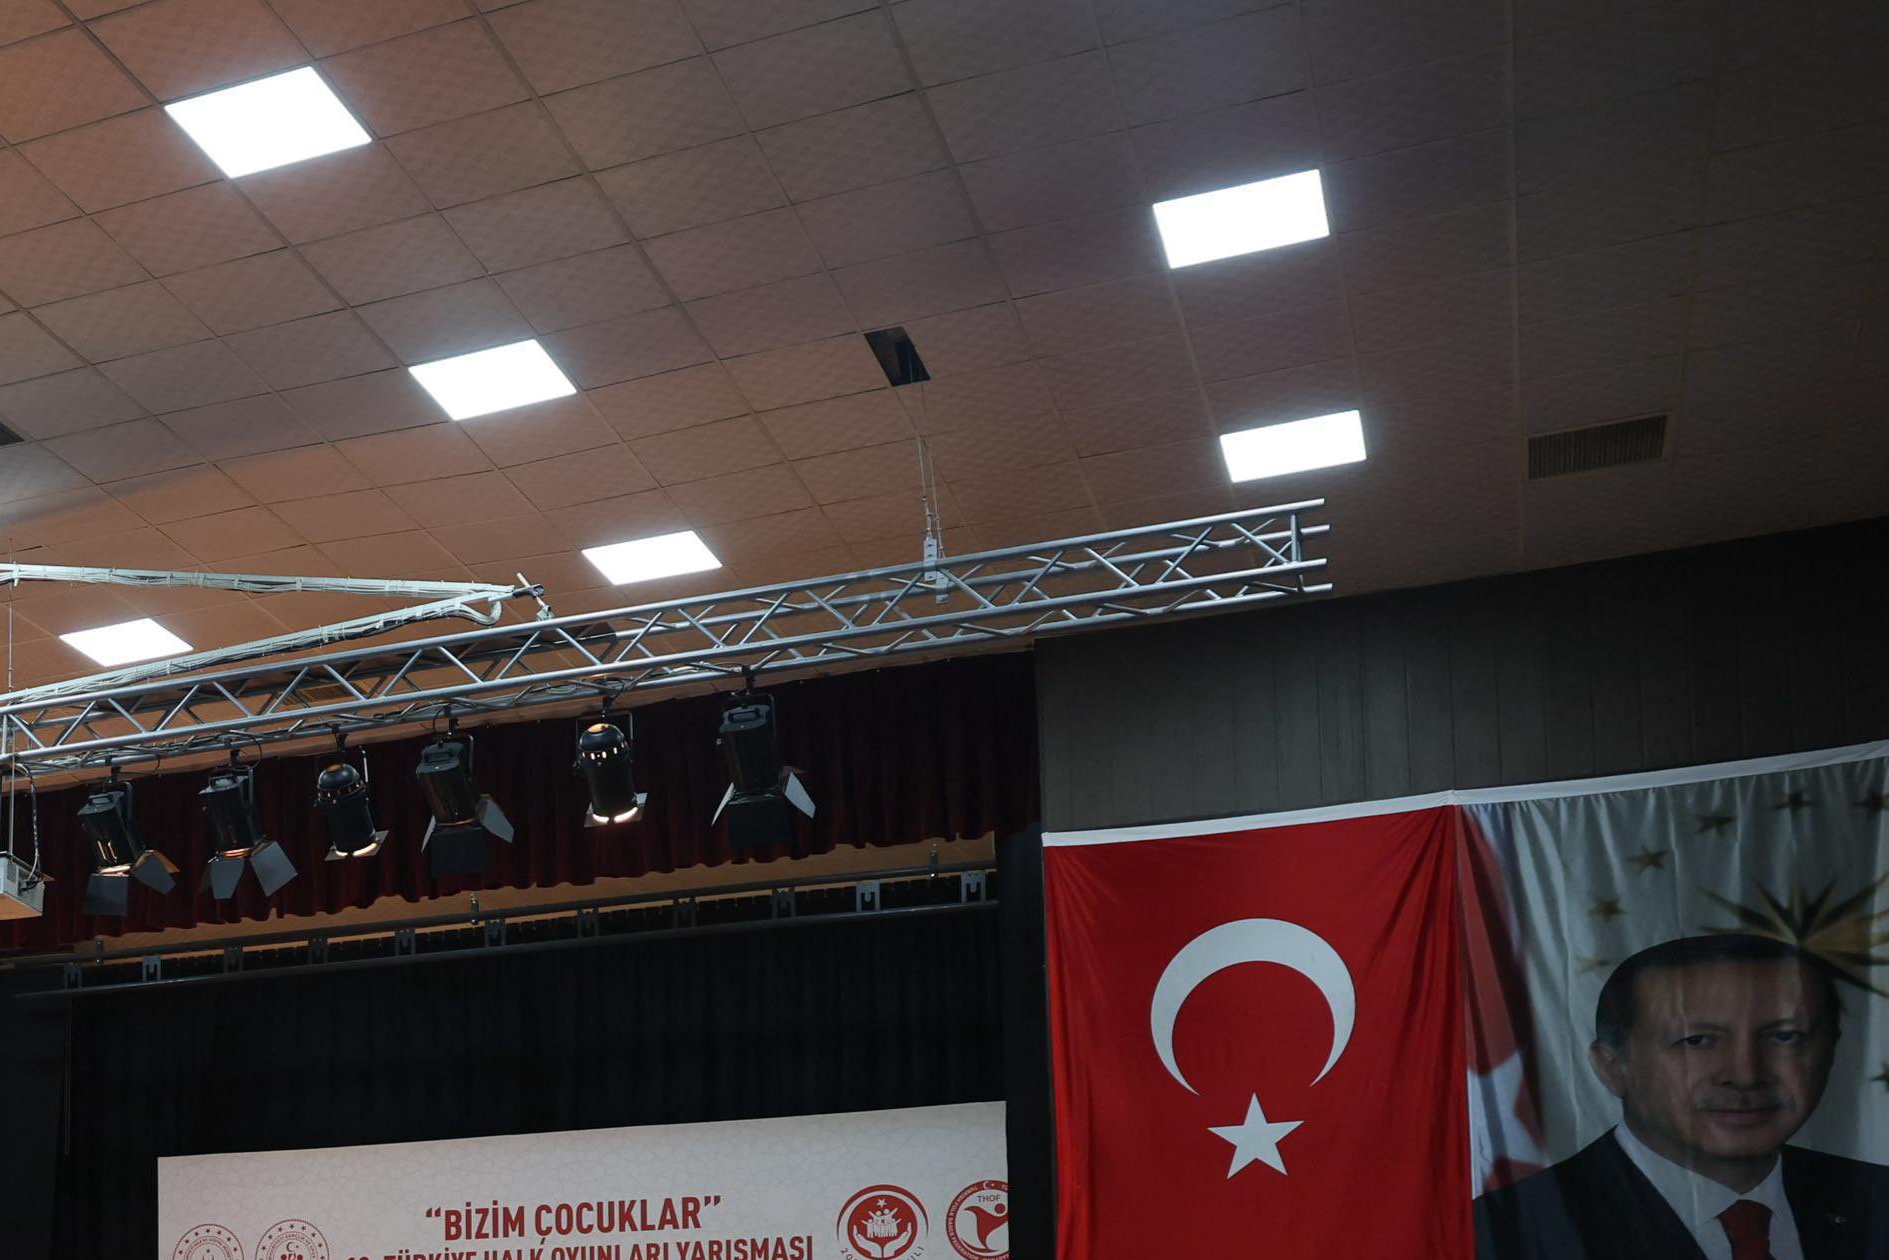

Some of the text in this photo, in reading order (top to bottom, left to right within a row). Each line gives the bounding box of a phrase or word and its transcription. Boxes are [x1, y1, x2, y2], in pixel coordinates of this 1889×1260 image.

[976, 1195, 1002, 1203] THOF
[425, 1195, 721, 1244] “BİZİM ÇOCUKLAR”
